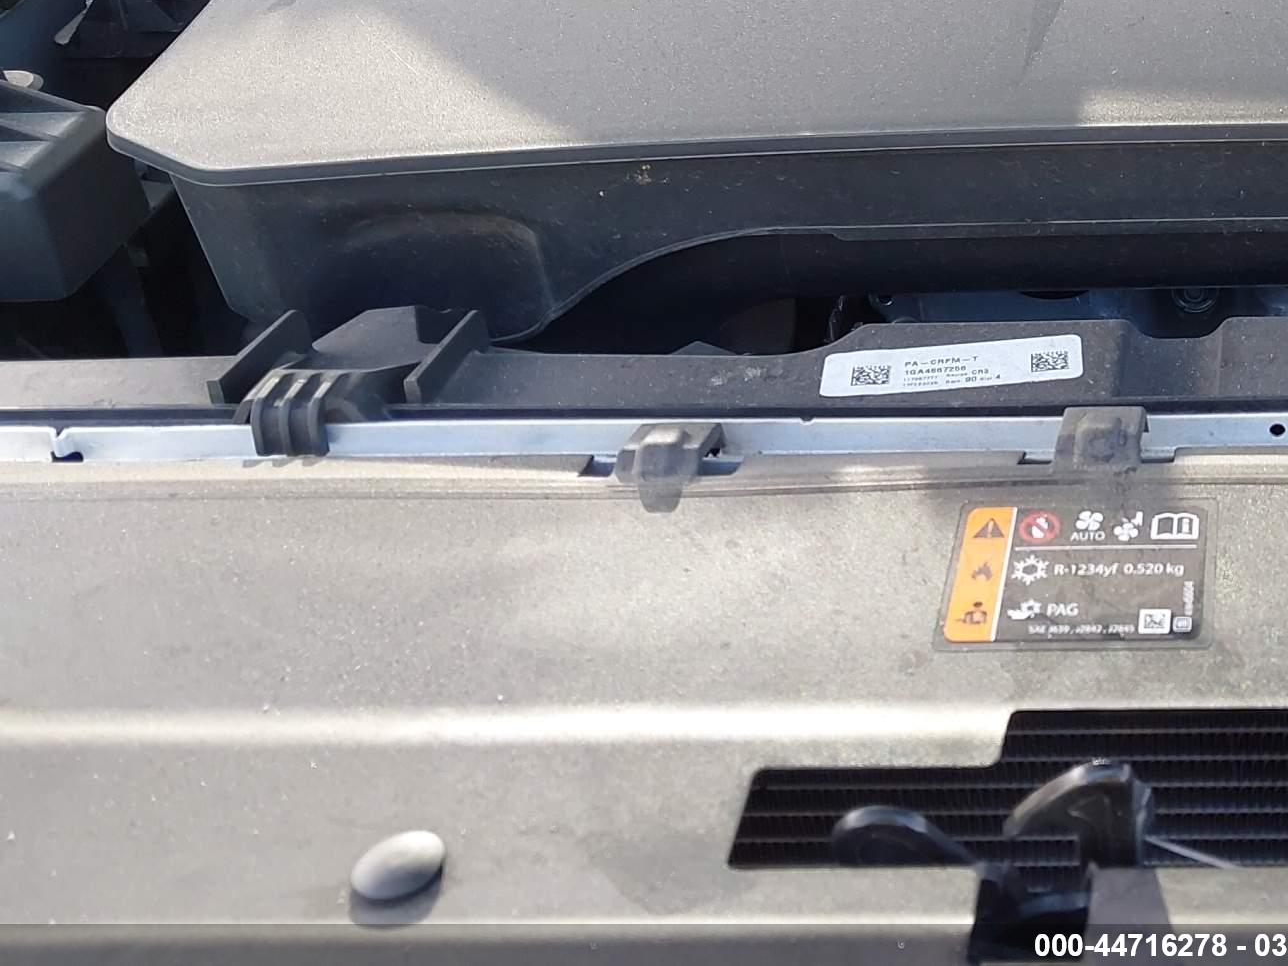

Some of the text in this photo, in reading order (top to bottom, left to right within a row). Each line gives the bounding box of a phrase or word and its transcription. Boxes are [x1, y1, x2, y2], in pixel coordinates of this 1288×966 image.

[1070, 531, 1106, 542] AUTO
[1053, 562, 1185, 577] R-1234yf 0.520 kg
[1046, 602, 1080, 617] PAG
